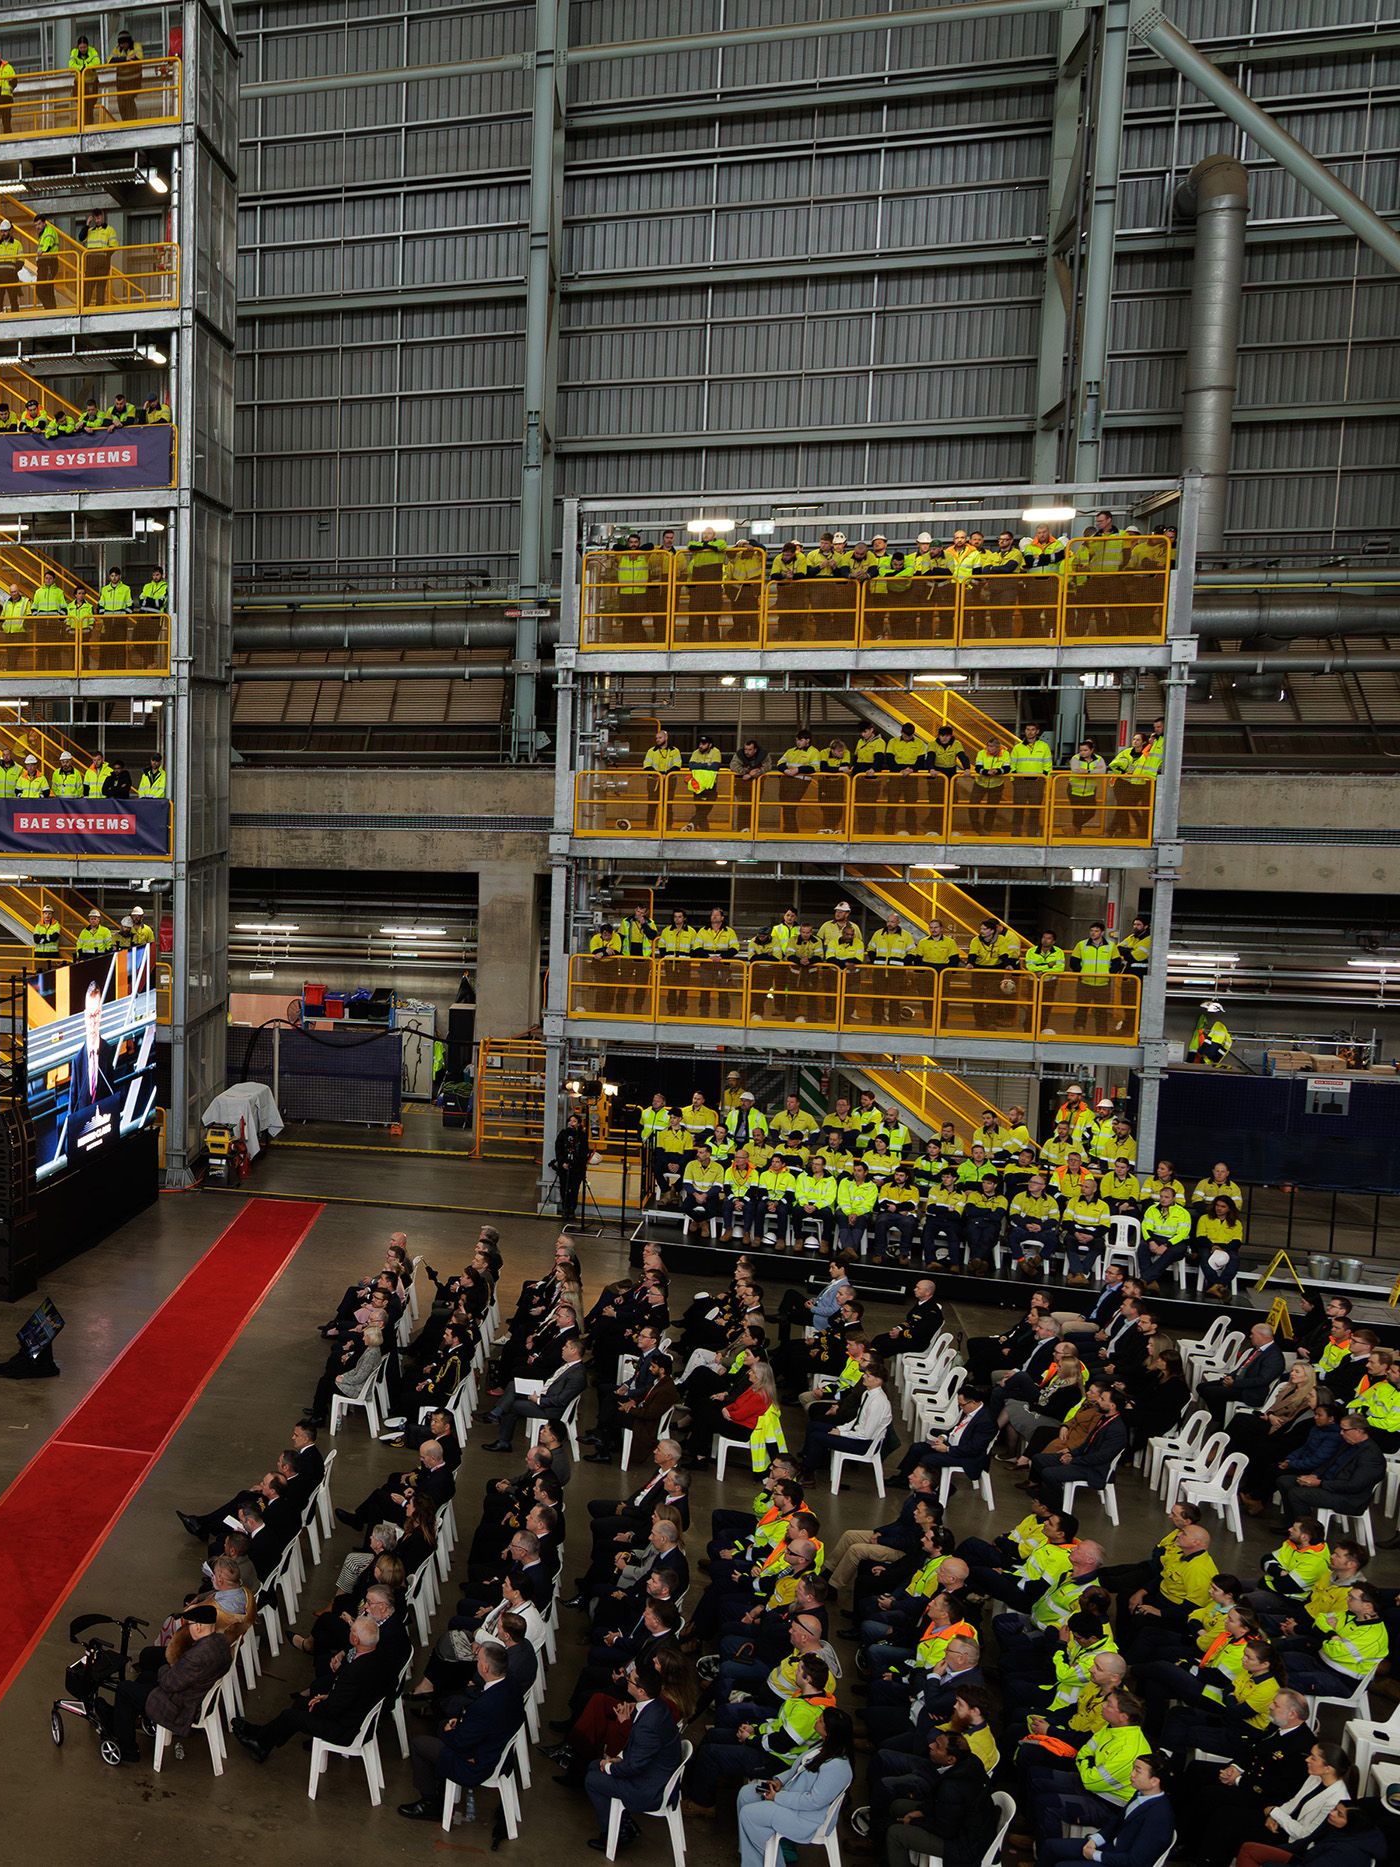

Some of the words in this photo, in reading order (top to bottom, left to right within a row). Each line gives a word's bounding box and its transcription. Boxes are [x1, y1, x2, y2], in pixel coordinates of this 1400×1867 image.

[18, 455, 50, 467] BAE
[55, 450, 131, 466] SYSTEMS
[20, 817, 50, 829] BAE
[55, 817, 130, 830] SYSTEMS
